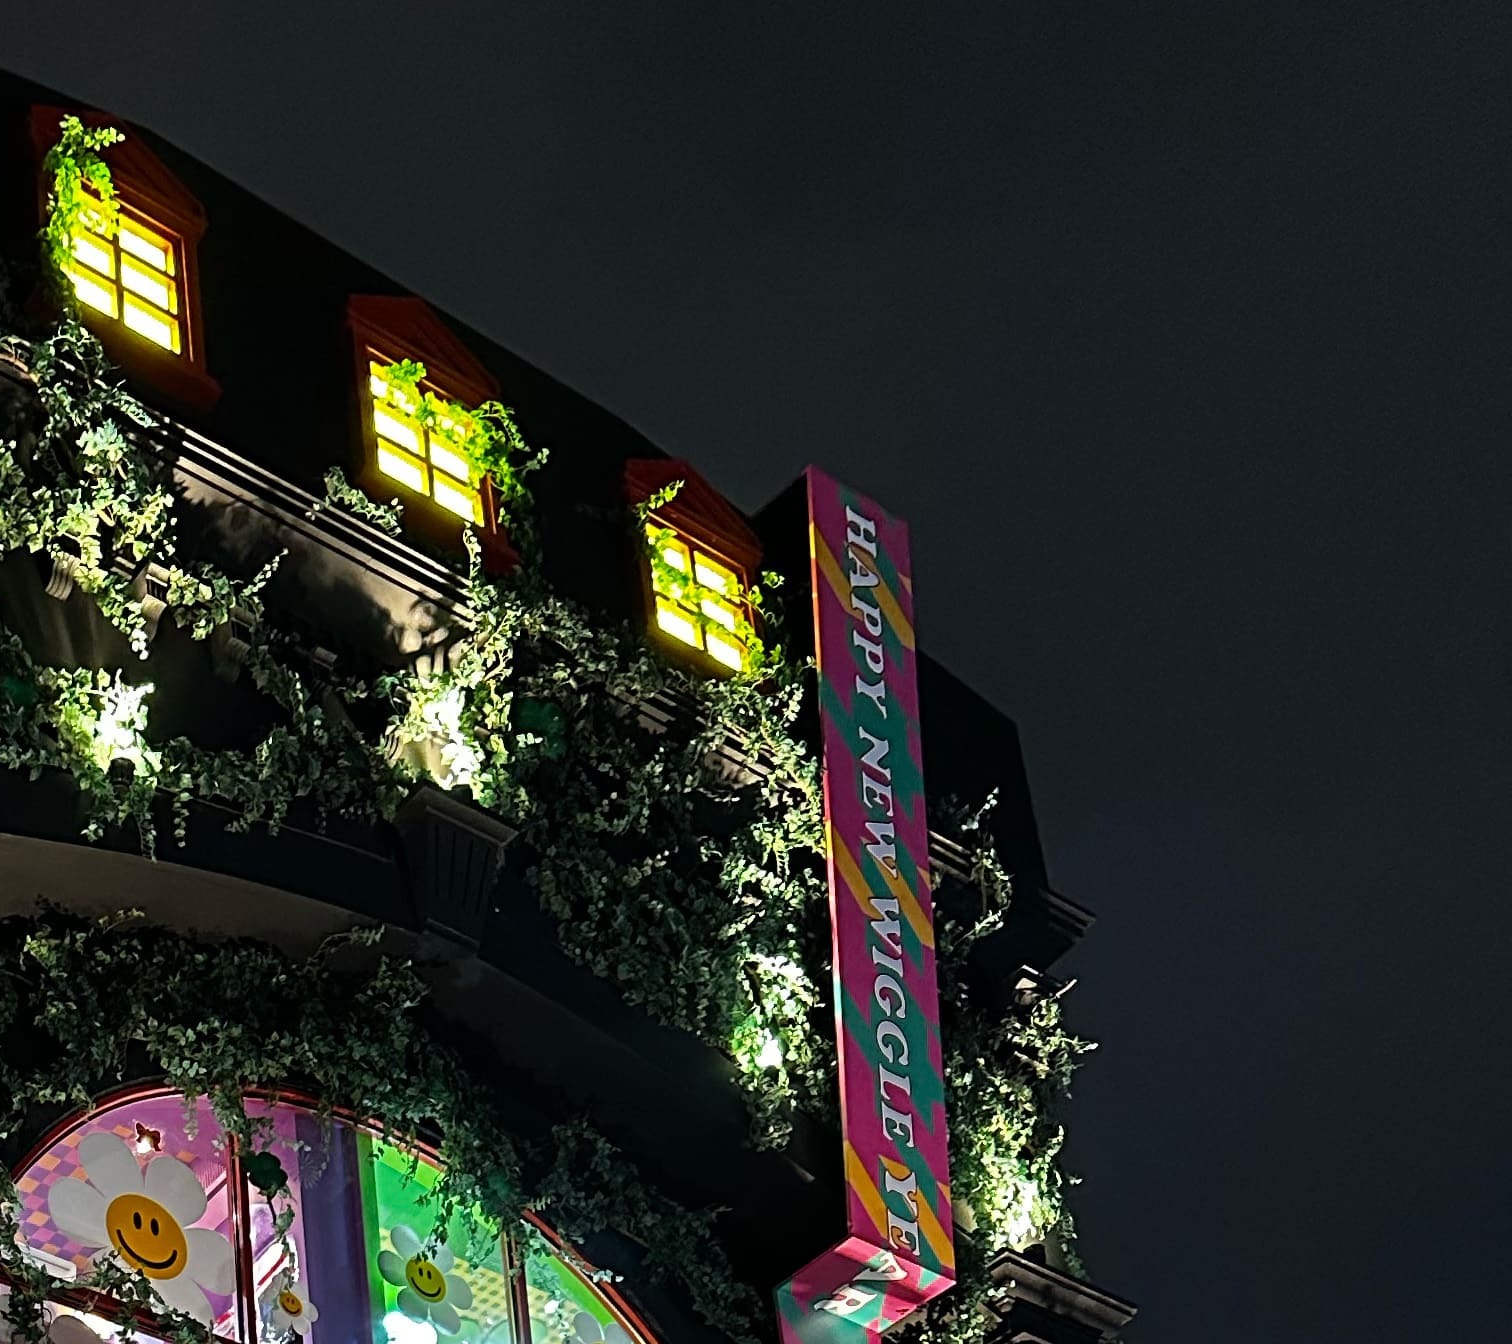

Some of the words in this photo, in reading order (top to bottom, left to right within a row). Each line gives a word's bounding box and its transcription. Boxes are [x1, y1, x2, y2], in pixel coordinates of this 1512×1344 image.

[845, 504, 888, 720] HAPPY
[859, 726, 899, 879] NEW
[870, 897, 915, 1149] WIGGLE
